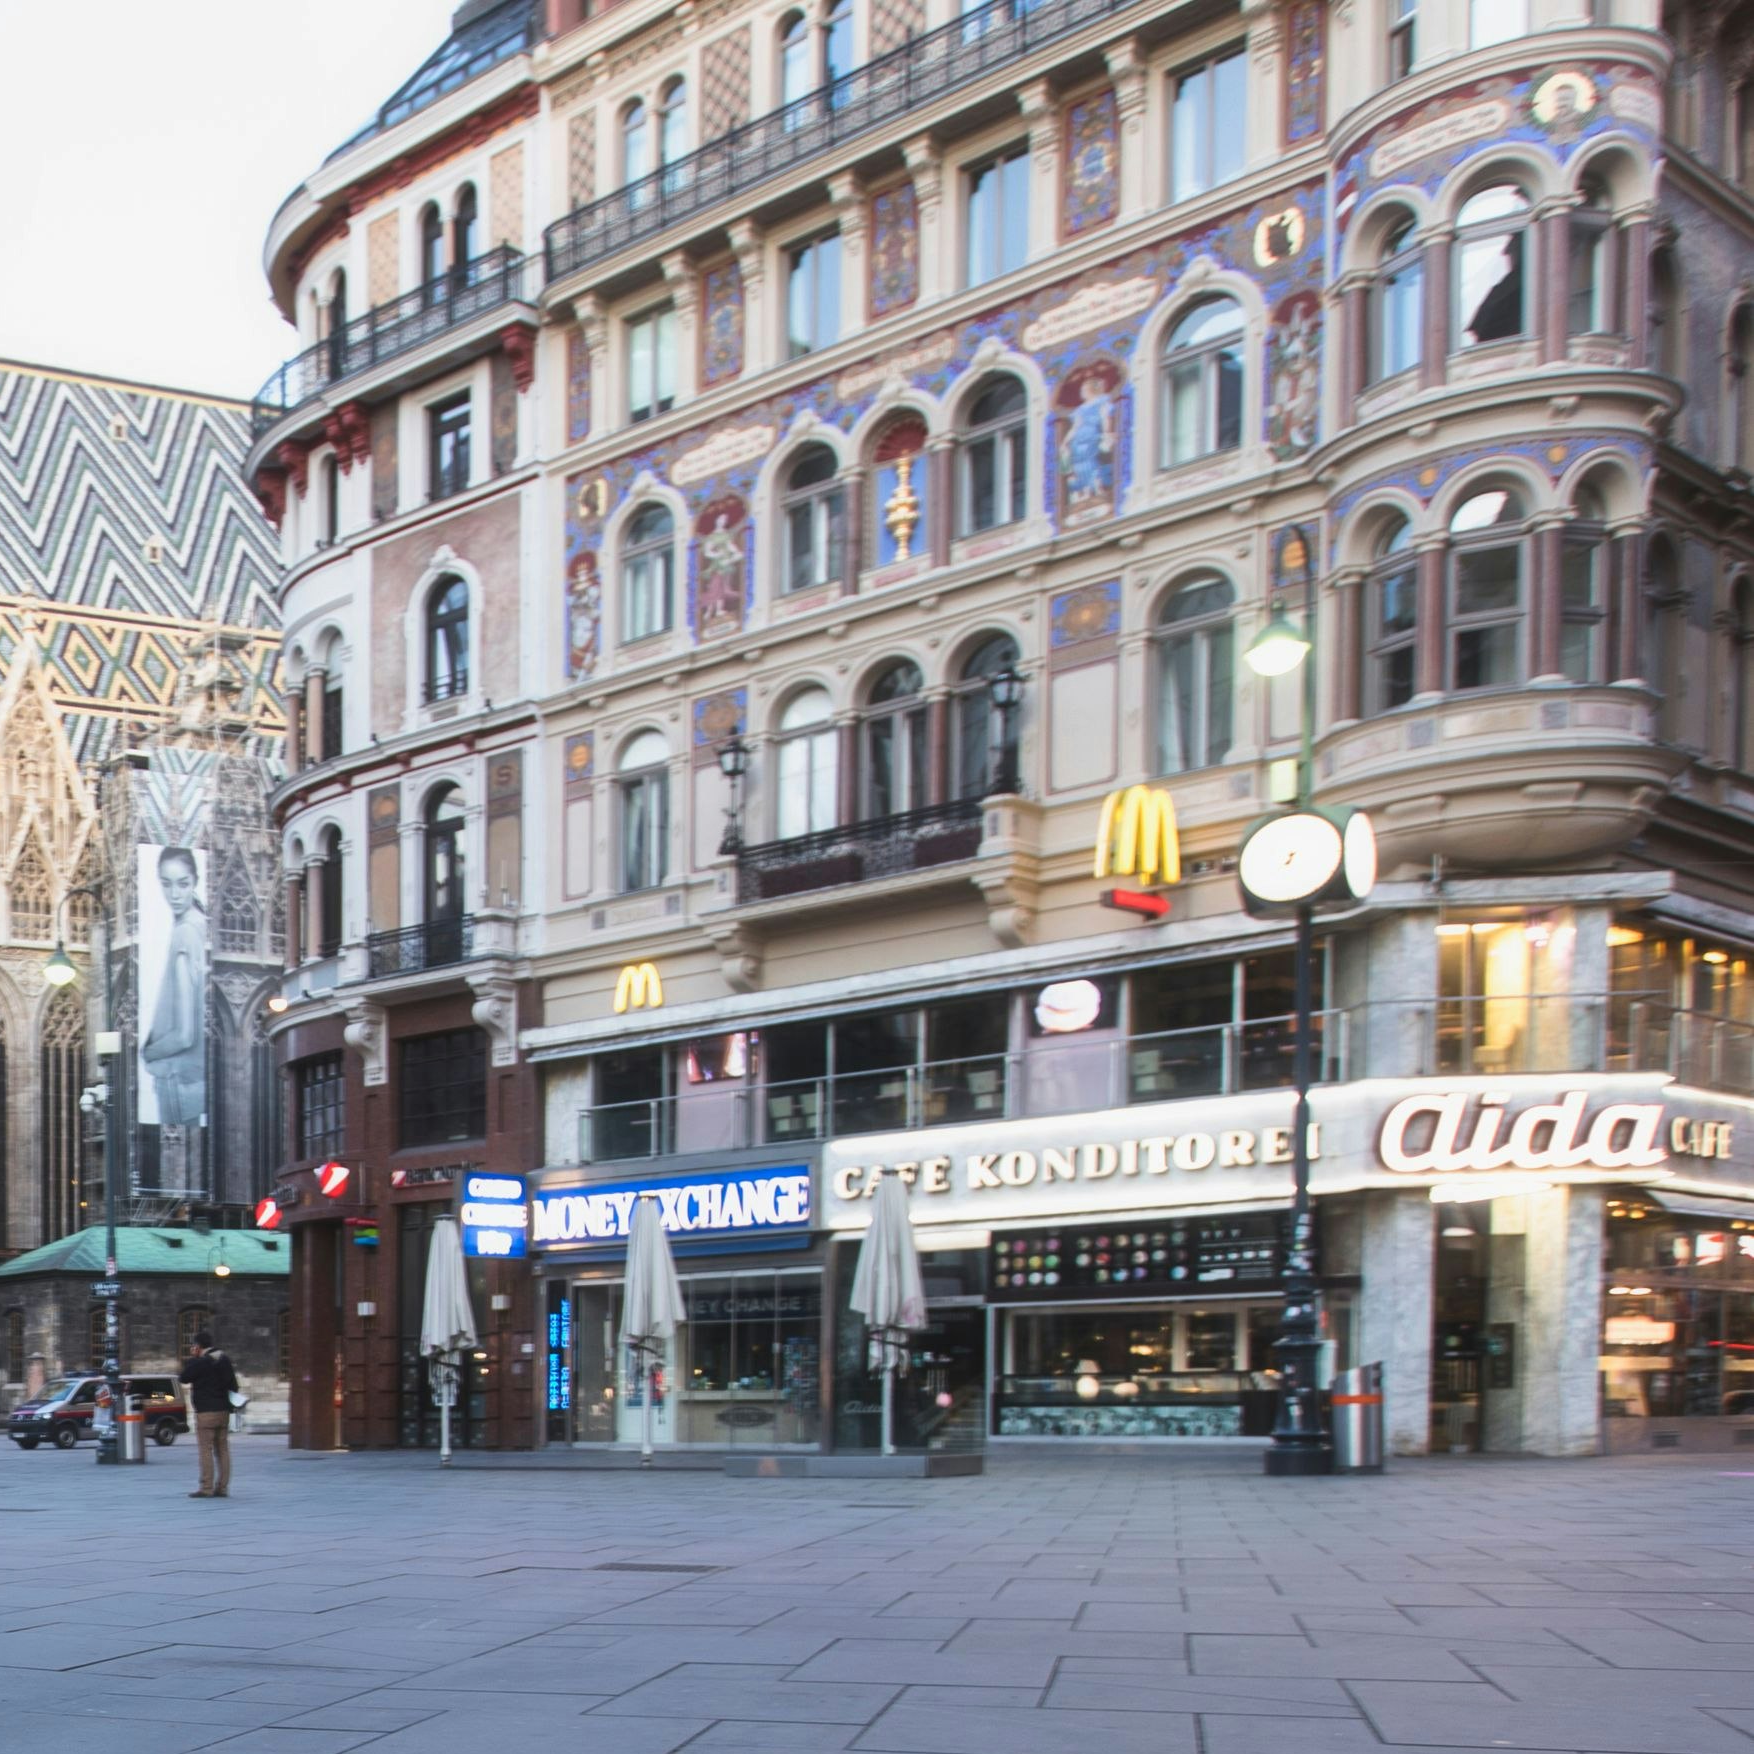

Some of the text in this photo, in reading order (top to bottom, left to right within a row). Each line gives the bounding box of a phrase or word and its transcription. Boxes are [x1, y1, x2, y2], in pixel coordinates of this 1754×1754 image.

[967, 1122, 1320, 1189] KONDITOREI
[532, 1190, 638, 1242] MONEY
[638, 1175, 810, 1232] XCHANGE
